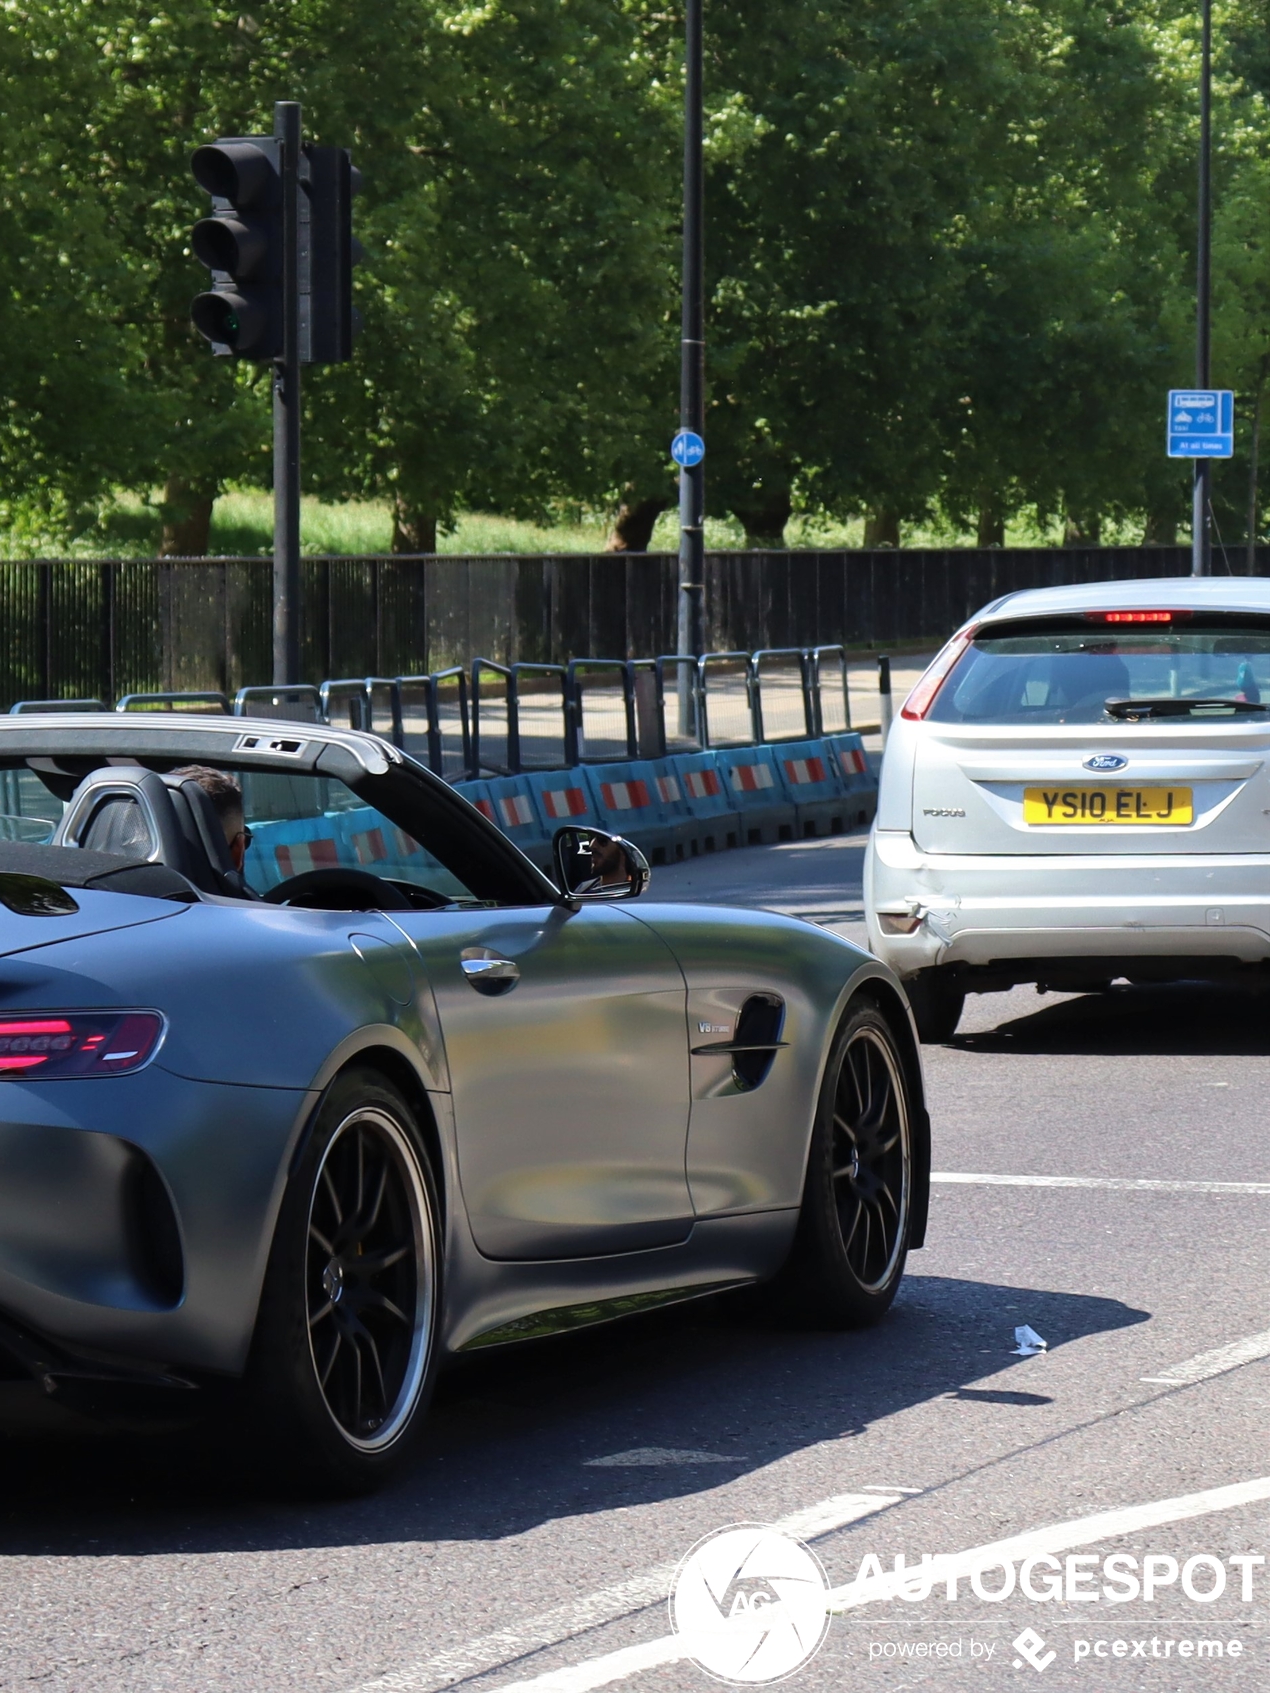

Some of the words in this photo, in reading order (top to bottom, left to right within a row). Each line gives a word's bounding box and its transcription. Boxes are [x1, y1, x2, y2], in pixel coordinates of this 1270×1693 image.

[1092, 756, 1119, 768] Ford
[1042, 792, 1107, 819] YS10
[922, 808, 966, 818] FOCUS
